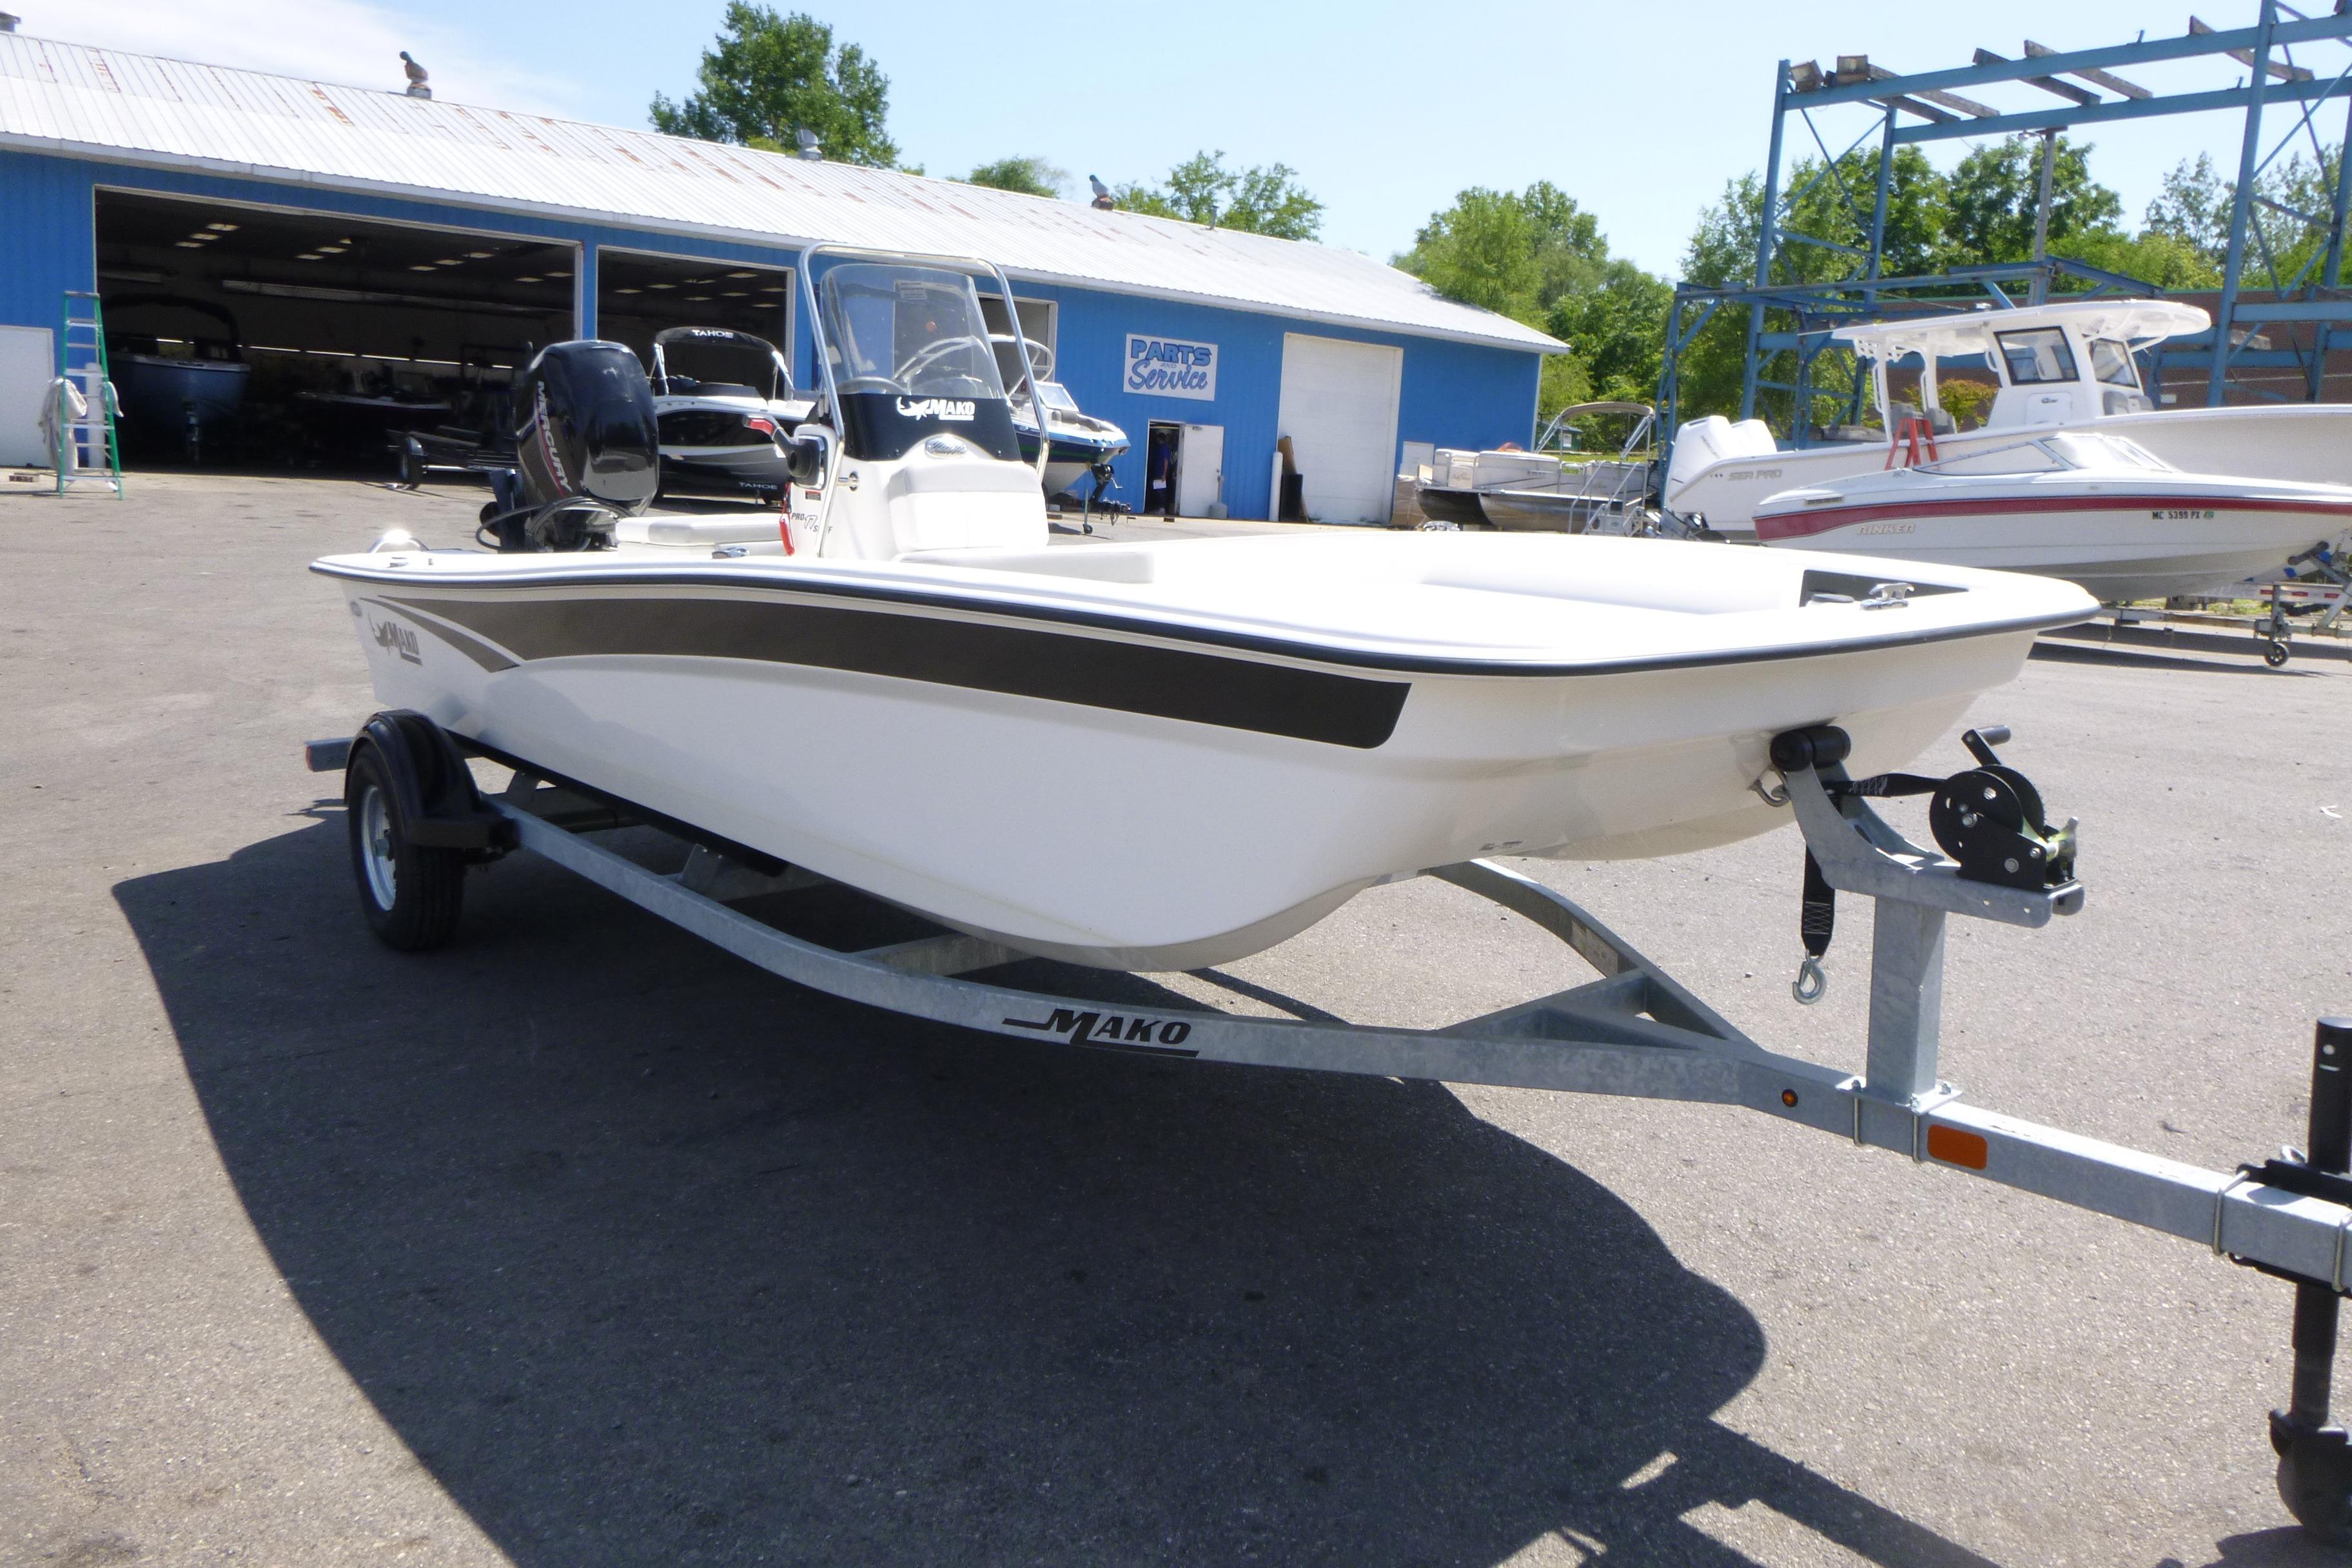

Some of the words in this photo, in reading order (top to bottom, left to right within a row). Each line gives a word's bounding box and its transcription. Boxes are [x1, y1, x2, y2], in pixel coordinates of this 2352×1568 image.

[692, 329, 734, 338] TAHOE
[1131, 339, 1212, 366] PARTS
[1128, 359, 1208, 390] Service
[925, 399, 975, 420] MAKO
[537, 380, 573, 493] MERCURY
[1728, 471, 1754, 481] SEA
[1755, 469, 1783, 479] PRO
[791, 513, 805, 521] PRO
[2152, 511, 2164, 520] MC
[1857, 524, 1916, 535] RINKER
[385, 621, 422, 665] MAKO
[1002, 1008, 1199, 1057] MAKO
